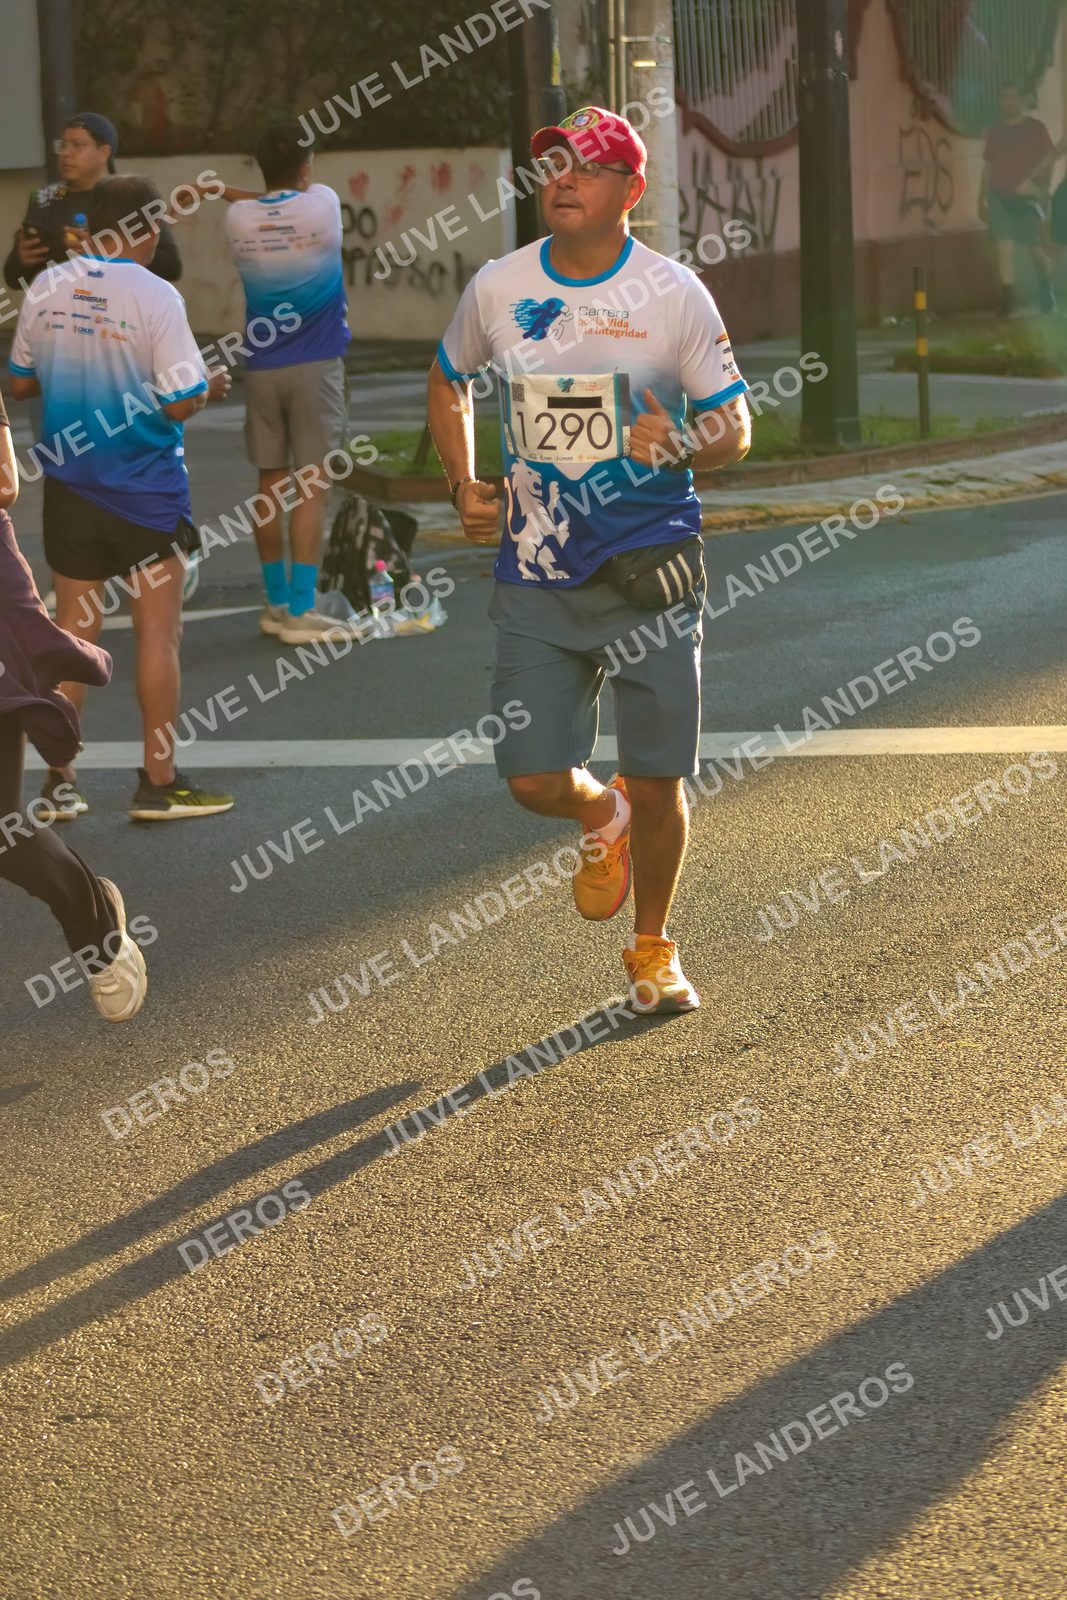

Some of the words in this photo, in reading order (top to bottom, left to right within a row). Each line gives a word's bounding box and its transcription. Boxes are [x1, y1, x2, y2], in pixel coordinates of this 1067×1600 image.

[578, 306, 629, 319] Carrera
[607, 318, 629, 329] Vida
[516, 411, 613, 451] 1290
